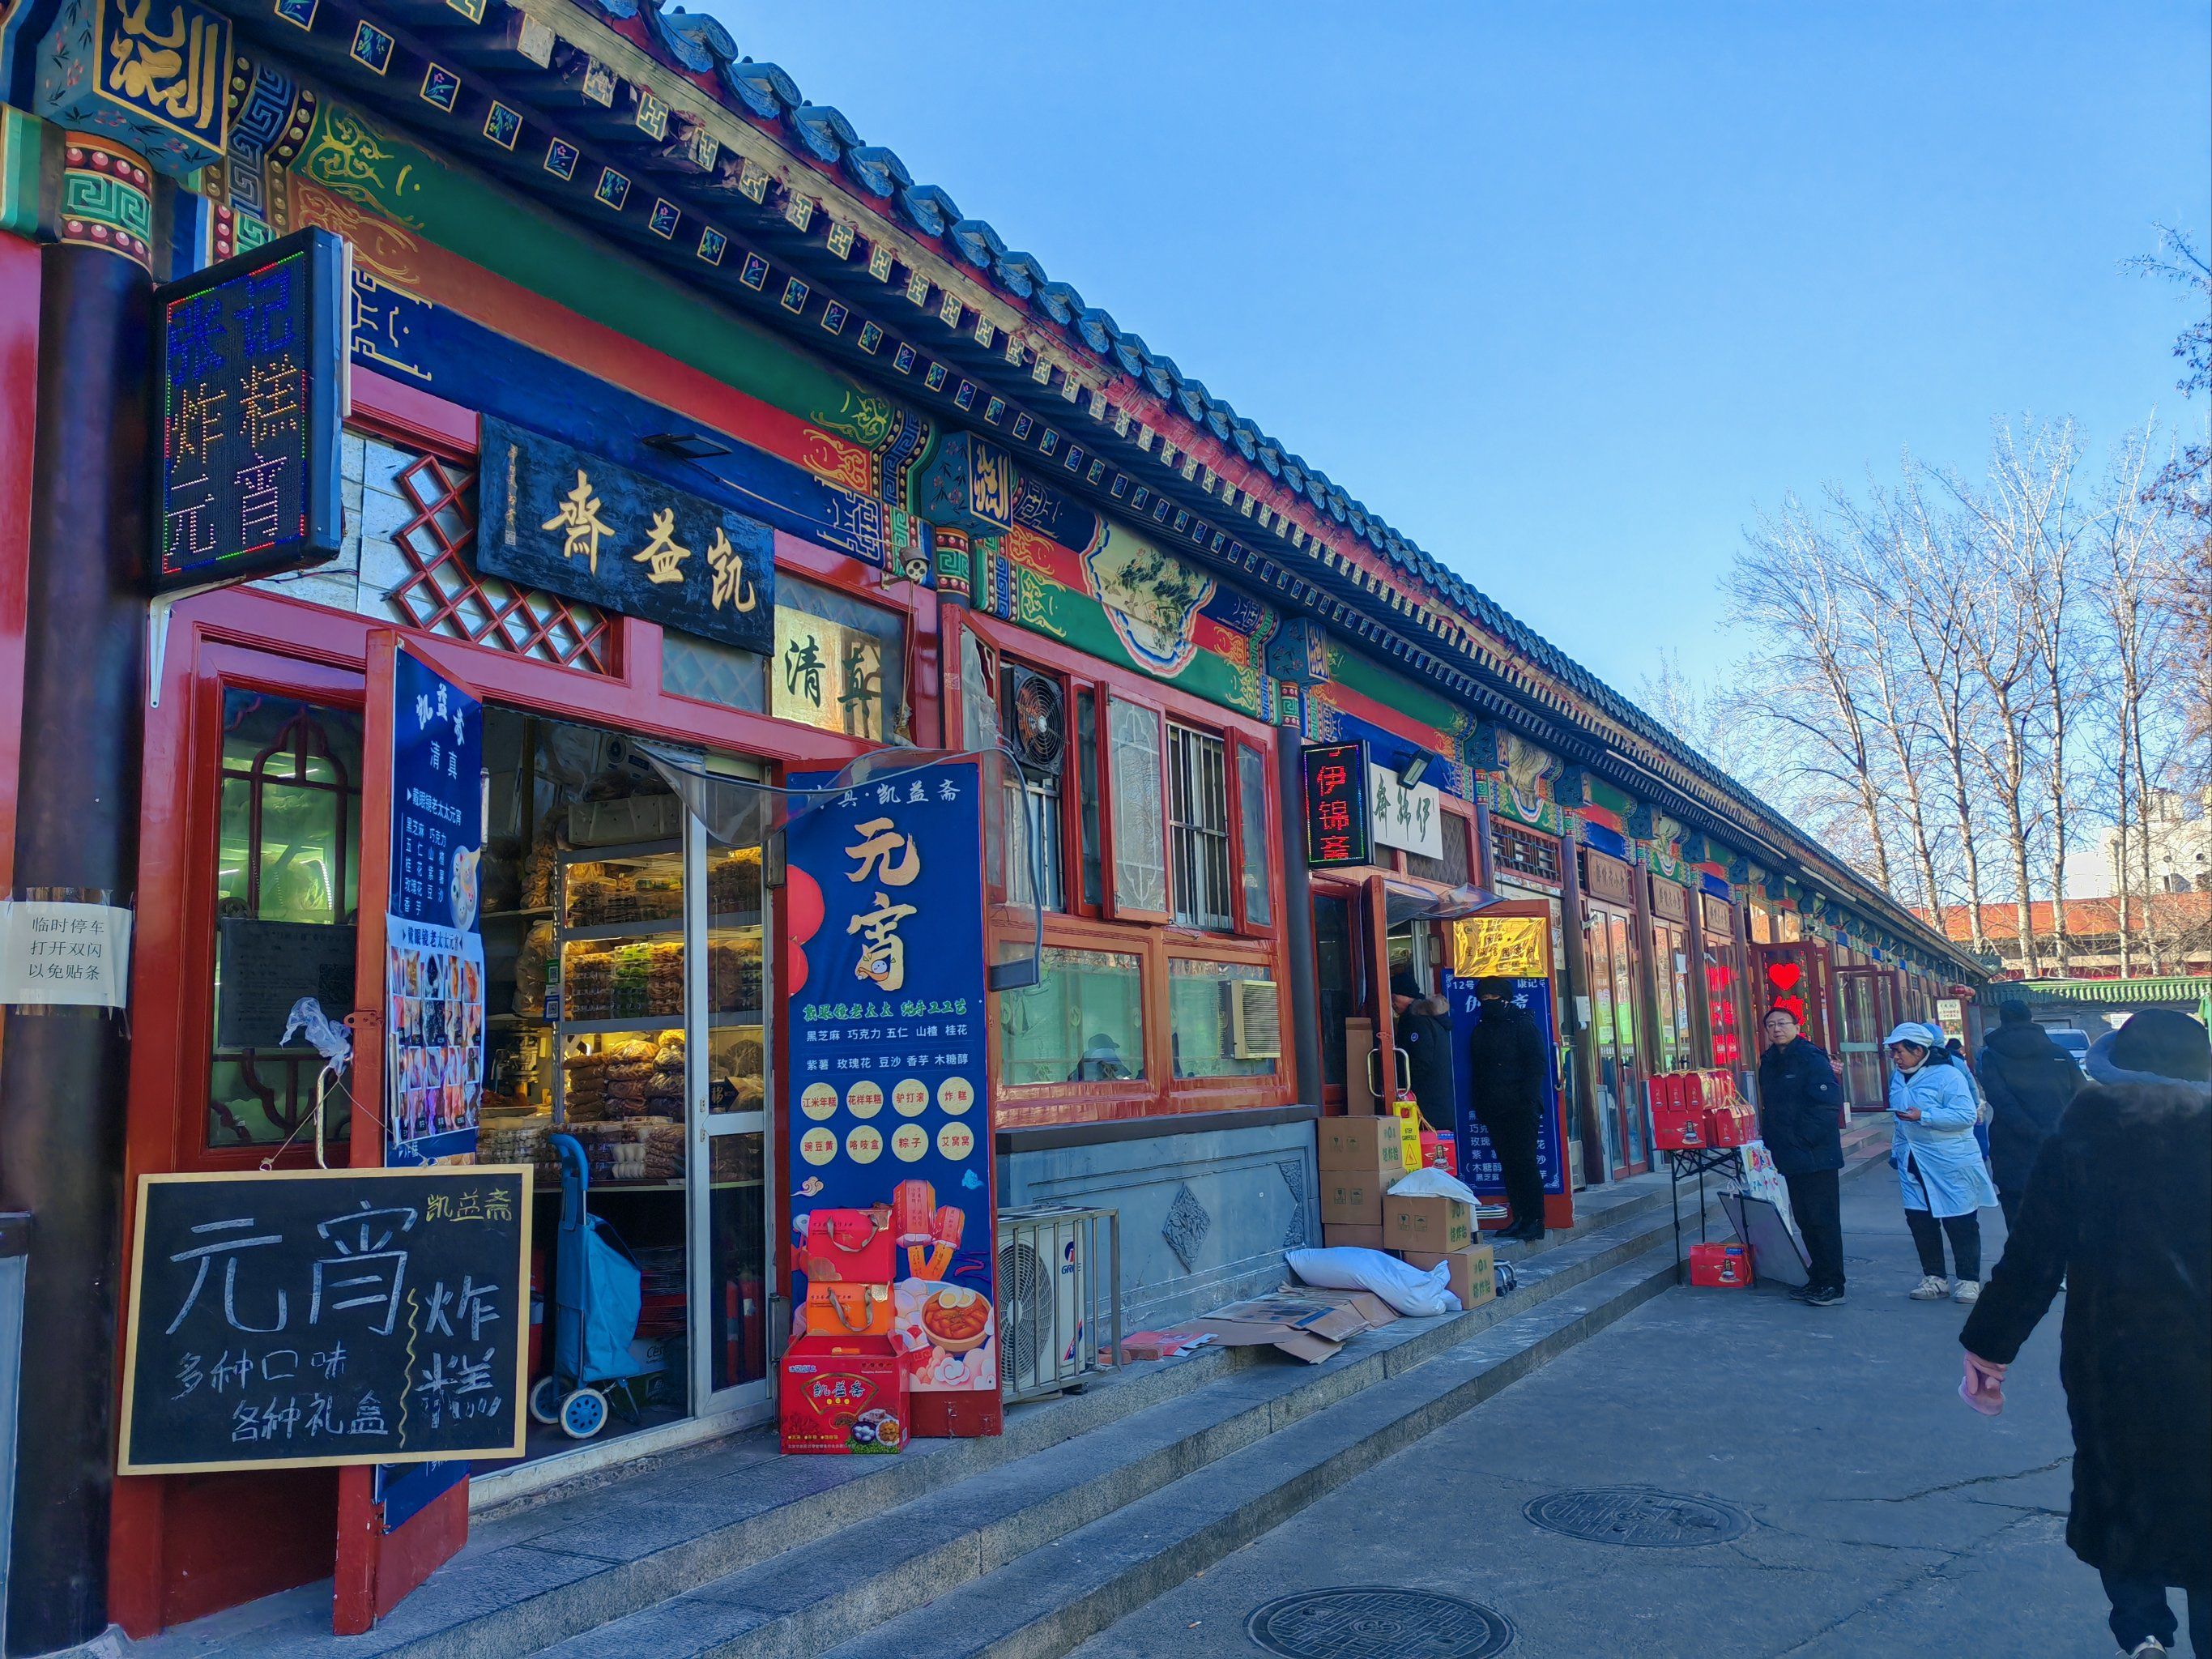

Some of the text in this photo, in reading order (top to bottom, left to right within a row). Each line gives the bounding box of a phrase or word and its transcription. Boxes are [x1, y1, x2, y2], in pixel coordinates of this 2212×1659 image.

[167, 267, 296, 387] 张记
[171, 354, 297, 474] 炸糕
[165, 452, 288, 557] 元宵
[785, 634, 872, 713] 清真
[430, 740, 458, 780] 清真
[406, 817, 446, 847] 黑芝麻 巧克力
[845, 817, 920, 991] 元宵
[32, 916, 104, 935] 临时停车
[30, 940, 102, 958] 打开双闪
[28, 963, 100, 980] 以免贴条
[1453, 979, 1474, 990] 12号
[802, 998, 968, 1021] 戴眼镜老太太 纯手工工艺
[807, 1024, 968, 1042] 黑芝麻 巧克力 五仁 山楂 桂花
[807, 1054, 969, 1070] 紫薯 玫瑰花 豆沙 香芋 木糖醇
[803, 1096, 837, 1108] 江米年糕
[848, 1094, 882, 1106] 花样年糕
[896, 1092, 925, 1103] 驴打滚
[944, 1090, 968, 1101] 炸糕
[804, 1141, 833, 1152] 豌豆黄
[898, 1137, 922, 1149] 粽子
[942, 1135, 970, 1146] 艾窝窝
[426, 1188, 512, 1222] 凯益斋
[166, 1199, 418, 1337] 元宵
[1061, 1262, 1082, 1275] GRE
[171, 1340, 347, 1401] 多种口味
[813, 1380, 865, 1398] 凯益斋
[231, 1390, 389, 1444] 各种礼盒
